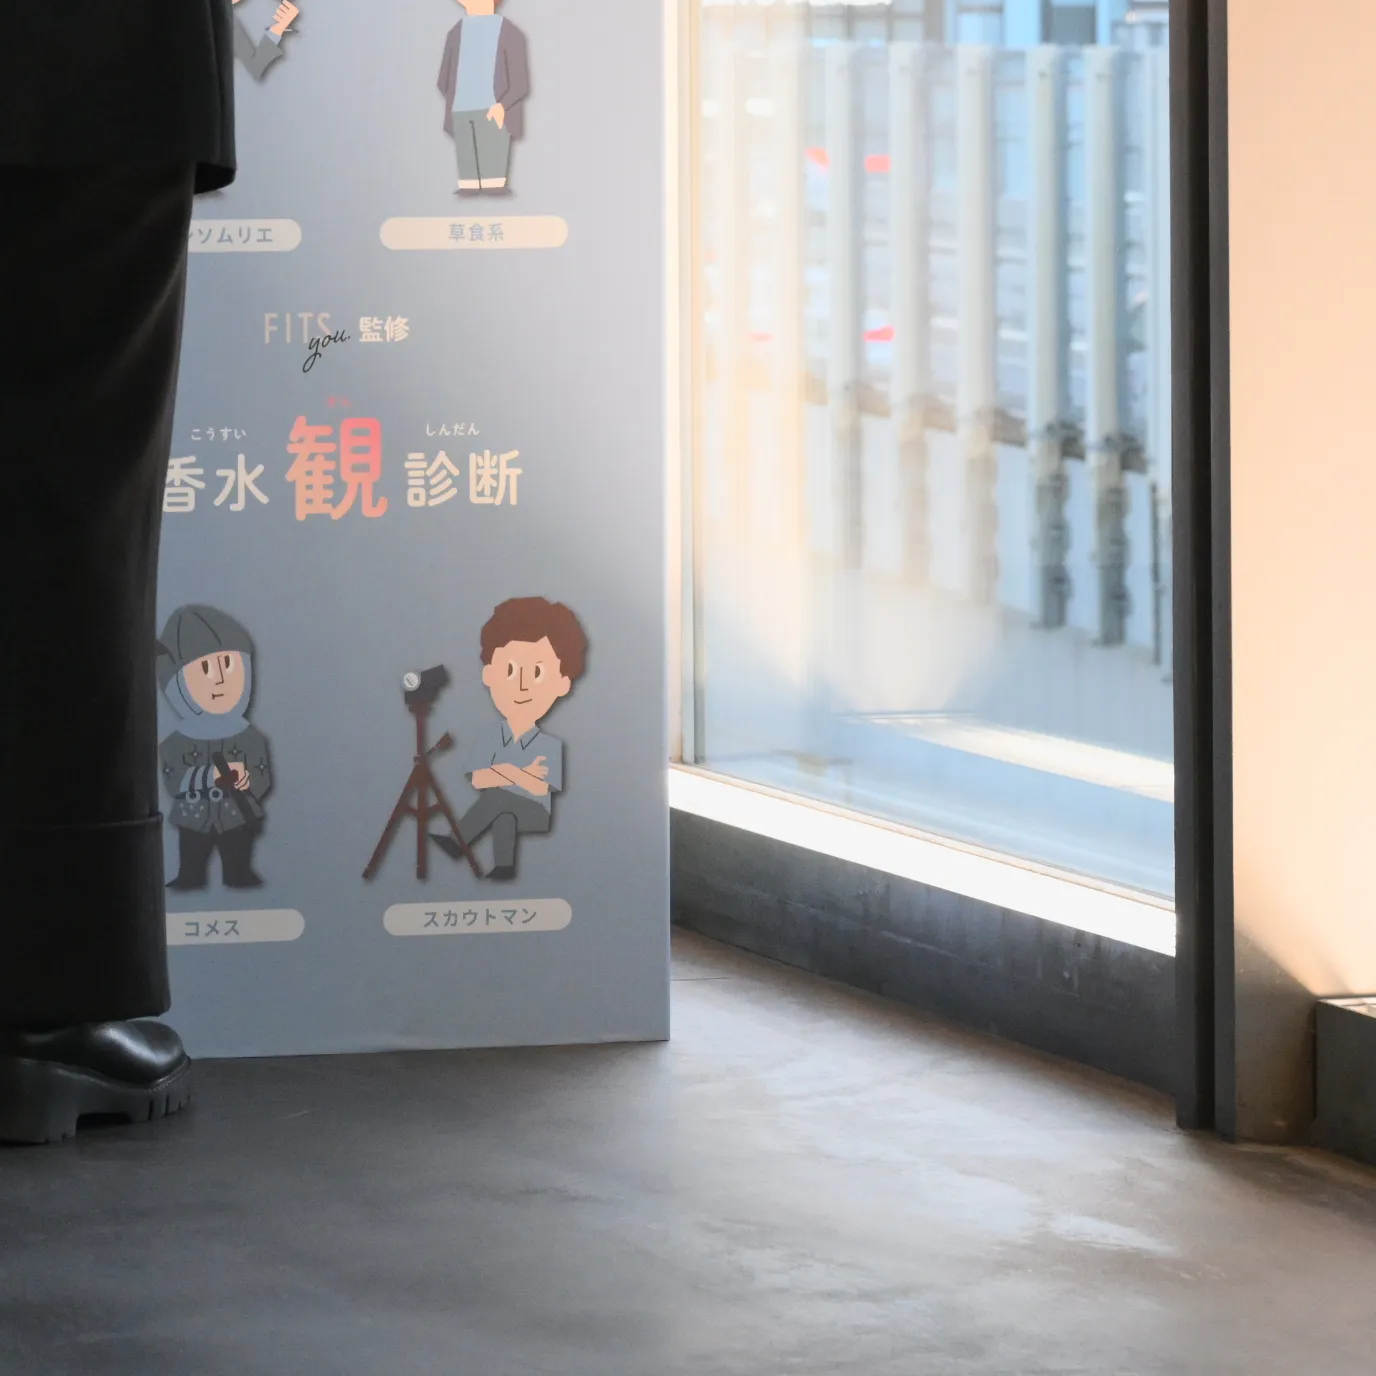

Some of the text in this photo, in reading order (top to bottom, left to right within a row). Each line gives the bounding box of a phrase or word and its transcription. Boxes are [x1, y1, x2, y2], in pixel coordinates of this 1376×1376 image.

[447, 223, 505, 242] 草食系
[264, 312, 332, 344] FITS
[359, 316, 410, 343] 監修
[190, 427, 247, 441] こうすい
[425, 422, 480, 436] しんだん
[423, 907, 538, 928] スカウトマン
